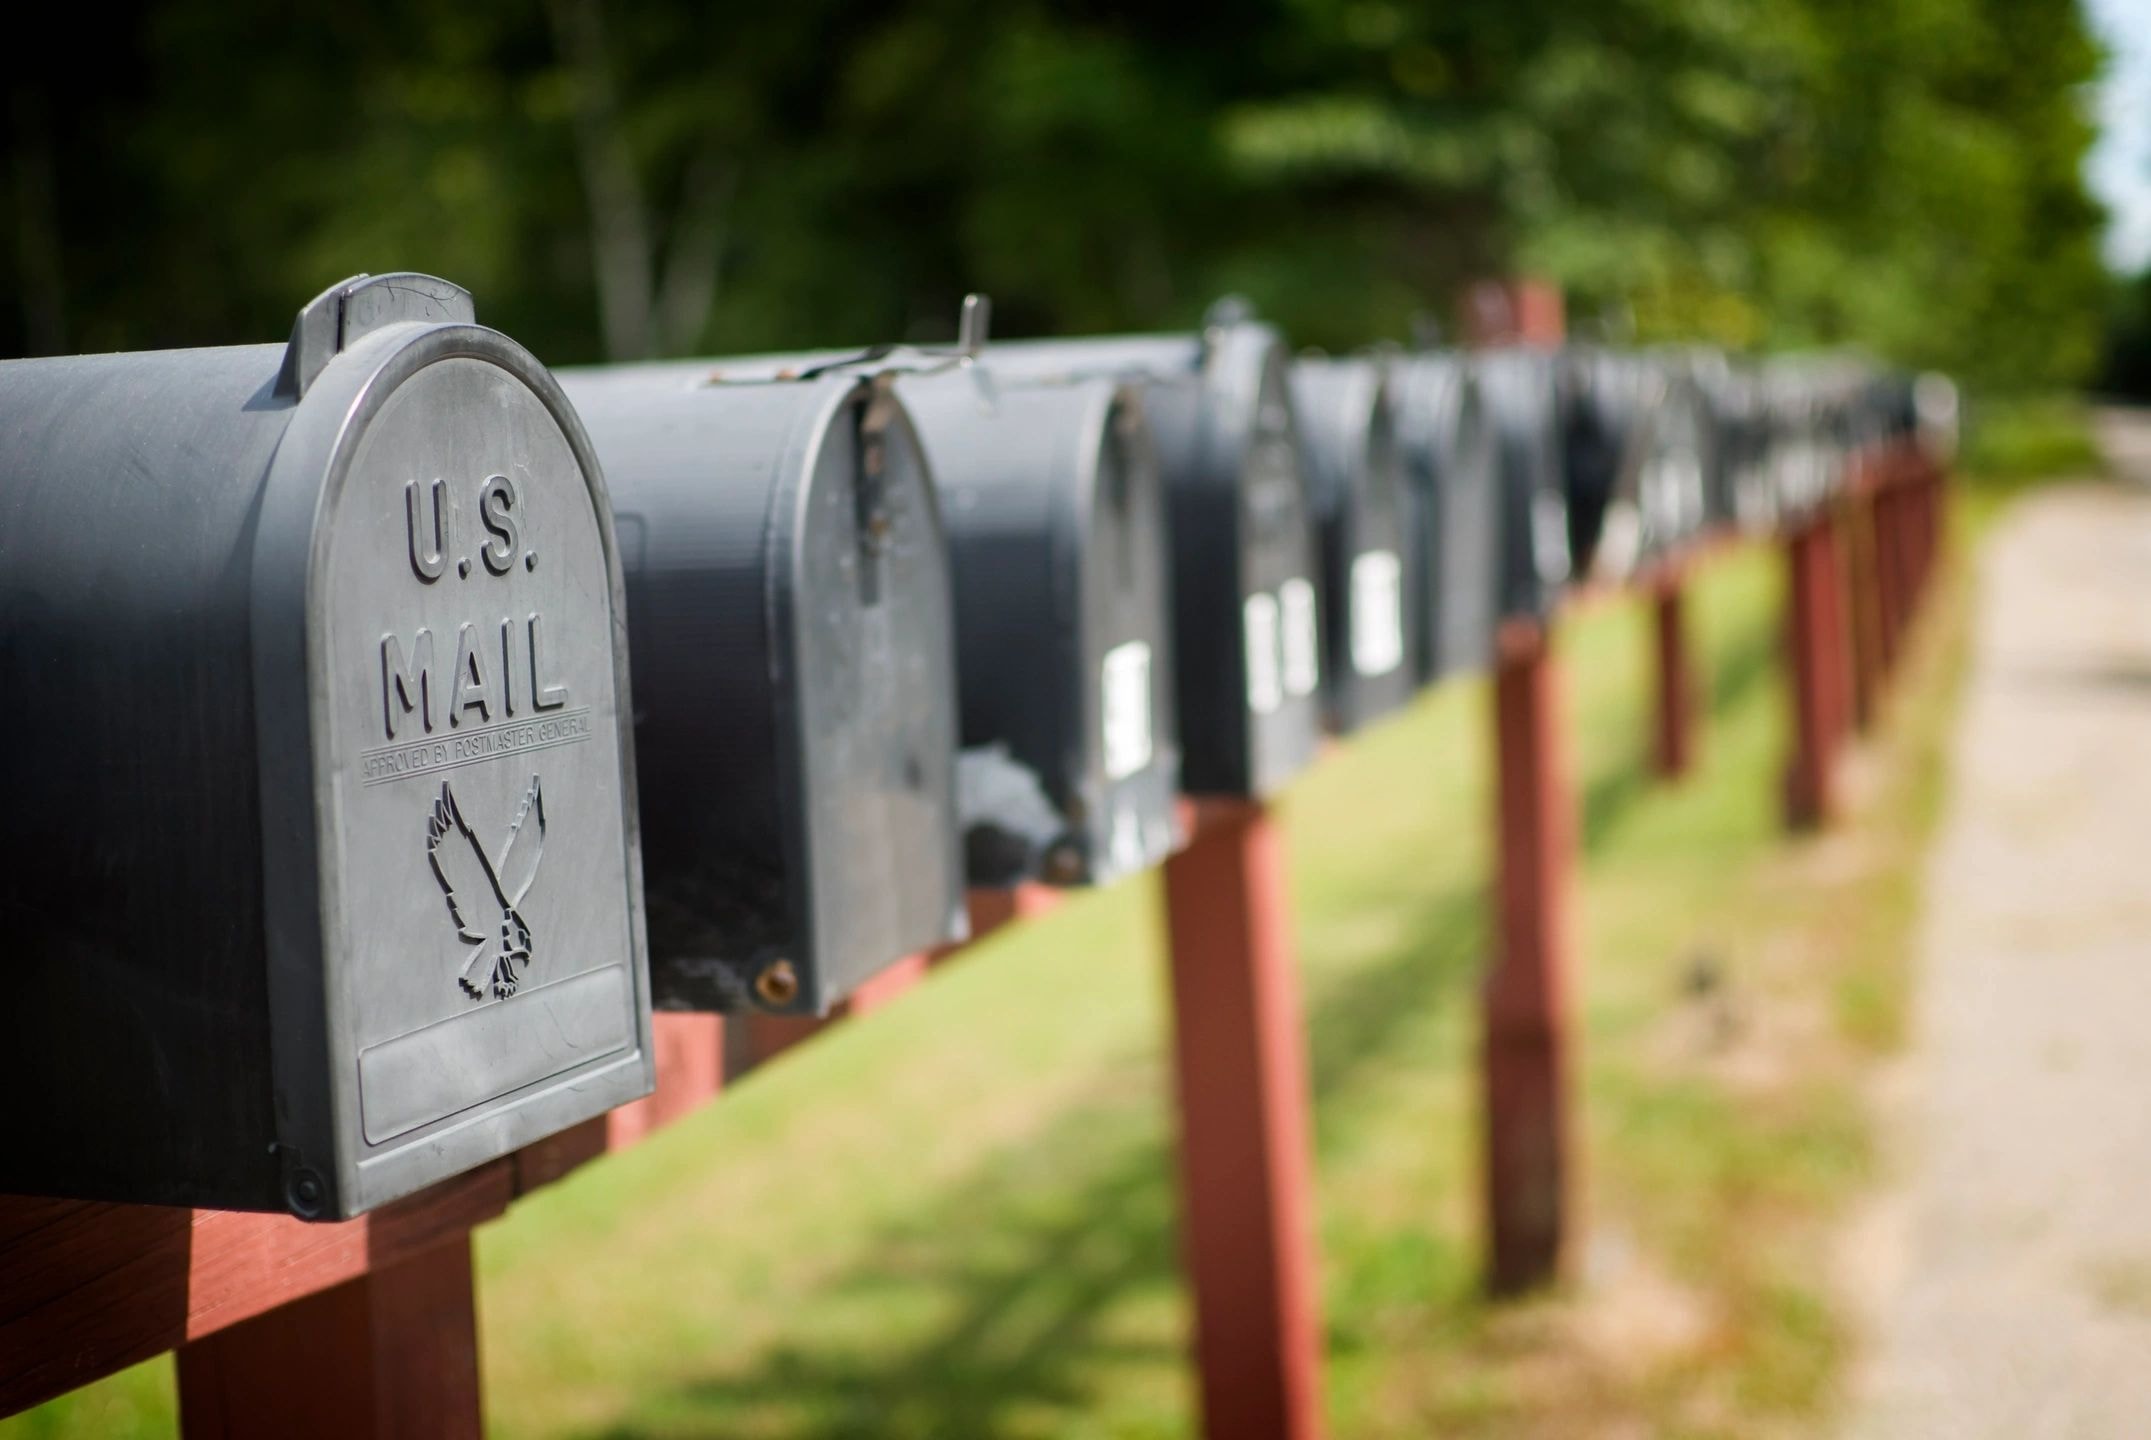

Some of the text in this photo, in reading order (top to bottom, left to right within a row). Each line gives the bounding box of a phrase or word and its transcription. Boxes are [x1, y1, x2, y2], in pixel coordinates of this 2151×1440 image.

[405, 474, 539, 585] U.S.
[380, 611, 569, 741] MAIL
[361, 716, 592, 779] APPROVED BY POSTMASTER GENERAL
